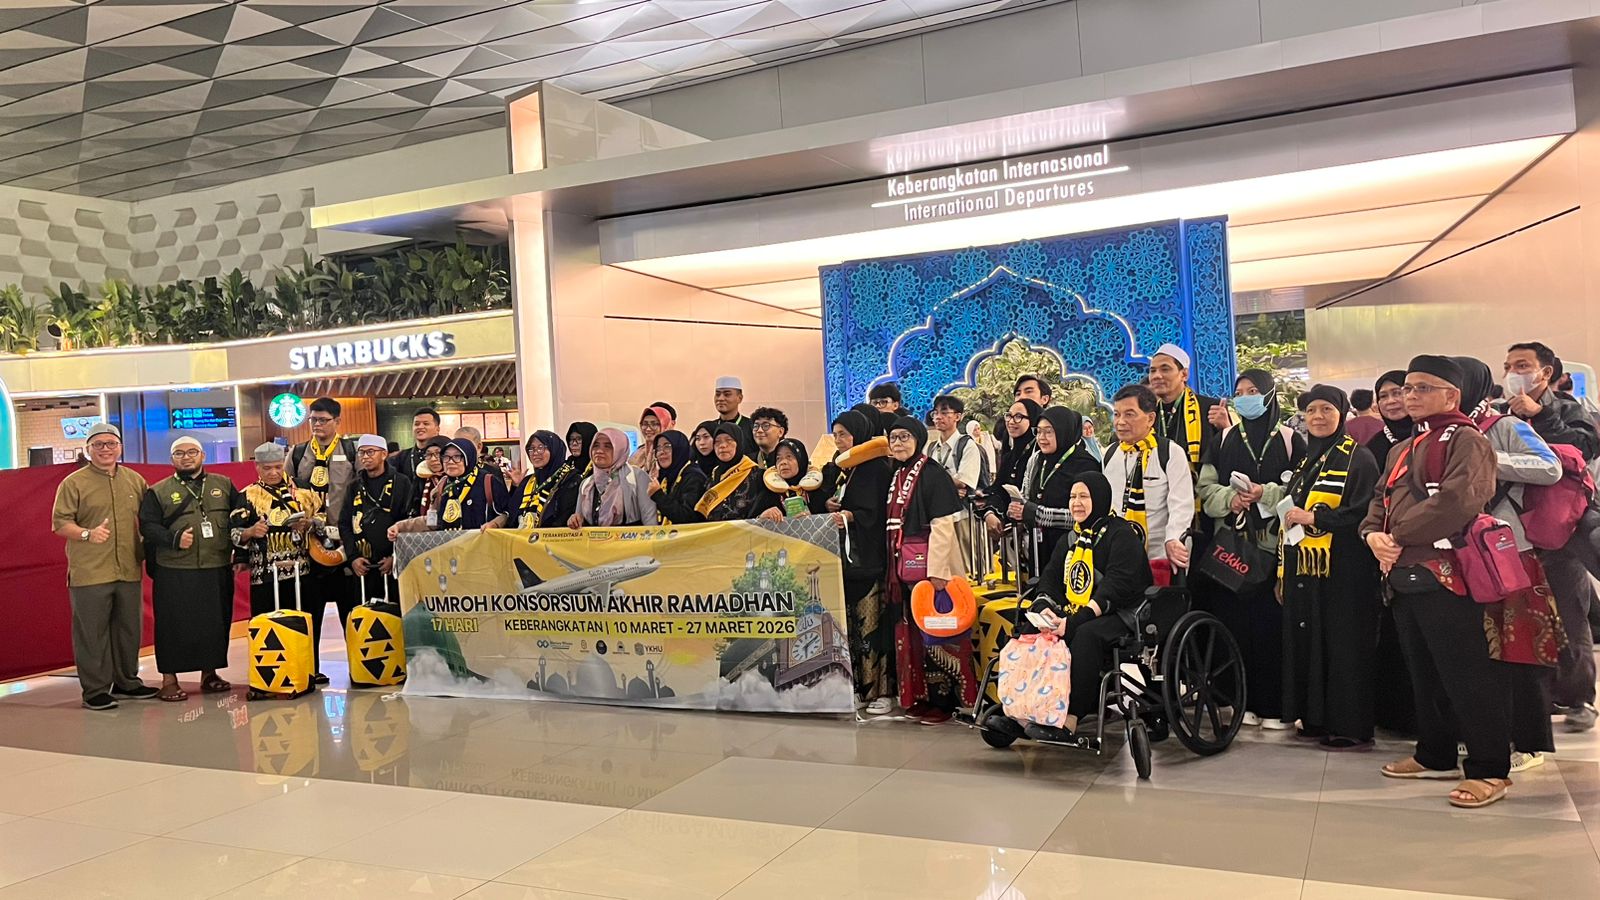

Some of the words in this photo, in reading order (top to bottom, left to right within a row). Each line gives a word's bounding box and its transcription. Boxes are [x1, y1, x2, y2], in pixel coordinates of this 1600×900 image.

[888, 167, 998, 197] Keberangkatan
[1003, 145, 1109, 180] Internasional
[904, 190, 999, 220] International
[1005, 180, 1094, 208] Departures
[288, 331, 446, 371] STARBUCKS
[621, 531, 638, 540] KAN
[1213, 544, 1249, 574] Tekko
[425, 595, 487, 613] UMROH
[491, 593, 604, 613] KONSORSIUM
[607, 594, 664, 613] AKHIR
[667, 592, 794, 613] RAMADHAN
[431, 617, 442, 632] 17
[444, 617, 479, 633] HARI
[505, 619, 603, 632] KEBERANGKATAN
[613, 621, 627, 634] 10
[630, 621, 674, 634] MARET
[685, 621, 701, 634] 27
[705, 621, 753, 634] MARET
[757, 620, 795, 634] 2026
